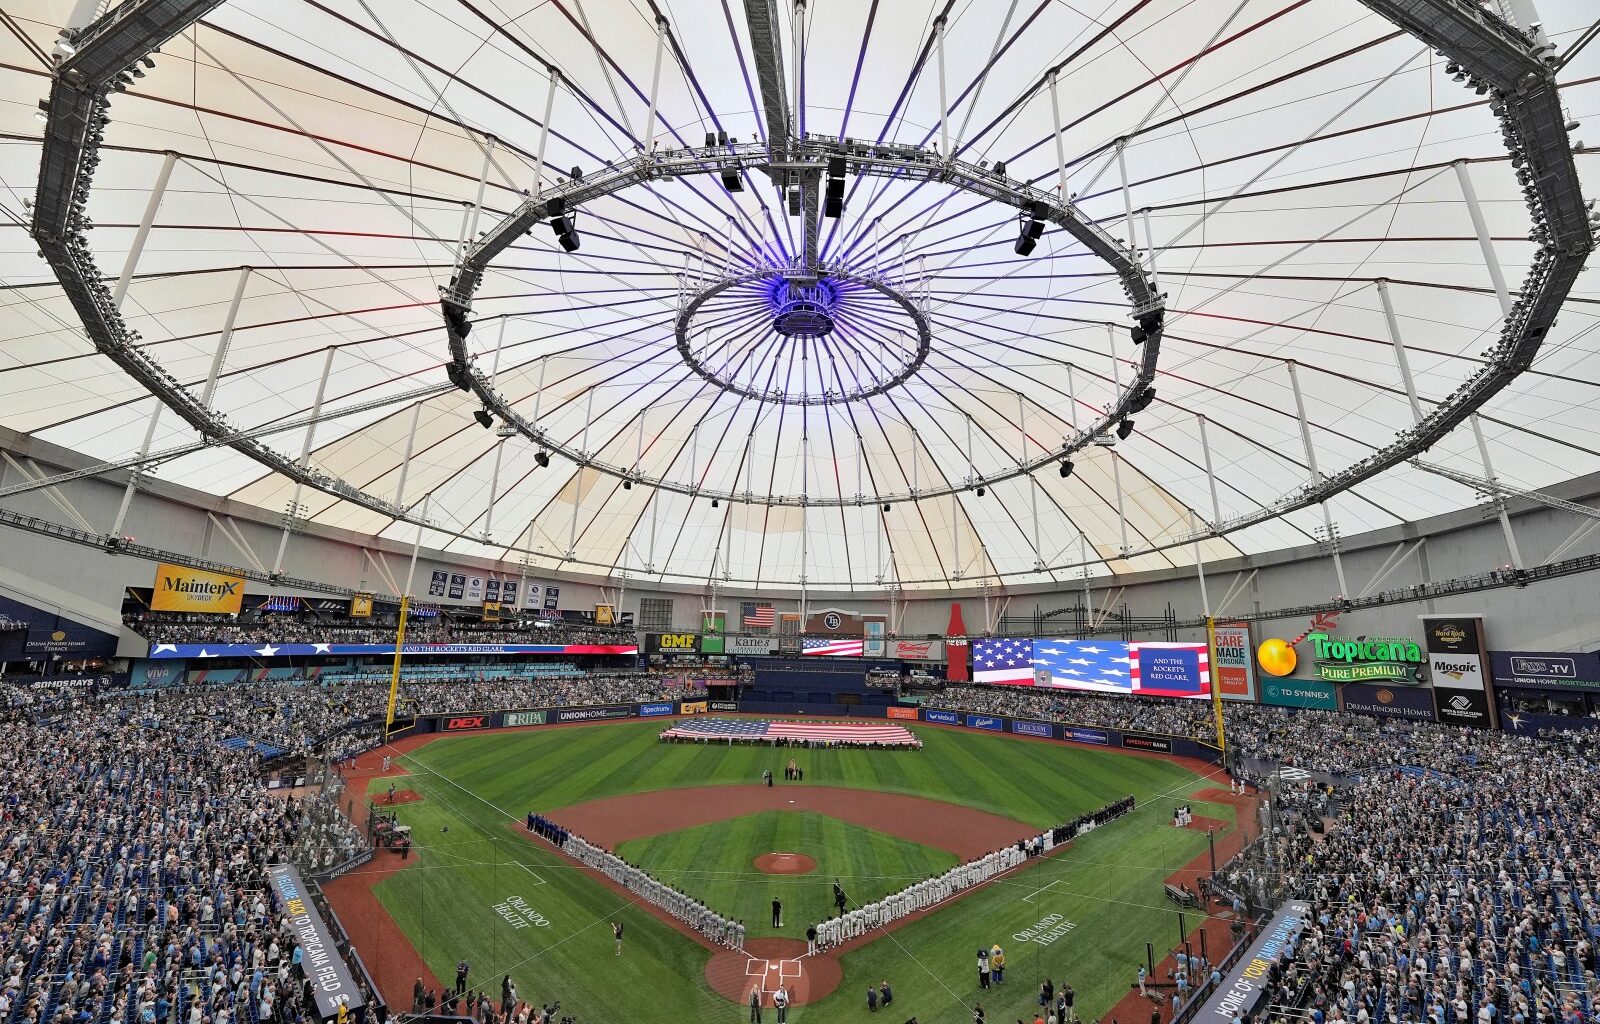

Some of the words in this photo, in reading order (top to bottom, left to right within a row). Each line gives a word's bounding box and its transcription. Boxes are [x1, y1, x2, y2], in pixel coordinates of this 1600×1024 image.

[162, 576, 240, 600] MaintenX
[187, 594, 212, 602] SKYDECK
[662, 634, 696, 648] GMF
[1215, 636, 1244, 647] CARE
[1308, 634, 1422, 662] Tropicana
[1216, 648, 1246, 658] MADE
[1322, 666, 1350, 678] PURE
[1352, 665, 1407, 678] PREMIUM
[1434, 662, 1476, 672] Mosaic
[1516, 659, 1548, 673] Rays
[146, 668, 169, 679] VIVA
[34, 680, 68, 689] SOMOS
[70, 678, 94, 687] RAYS
[1294, 690, 1330, 699] SYNNEX
[644, 706, 668, 714] Spectrum
[1346, 702, 1372, 712] DREAM
[1372, 704, 1402, 714] FINDERS
[1403, 707, 1432, 716] HOMES
[448, 716, 484, 729] DEX
[518, 712, 542, 724] RIPA
[276, 874, 300, 900] WELCOME
[286, 898, 307, 916] BACK
[506, 895, 550, 927] ORLANDO
[294, 914, 311, 925] TO
[491, 902, 530, 930] HEALTH
[1012, 913, 1063, 942] ORLANDO
[1032, 920, 1077, 946] HEALTH
[1271, 926, 1288, 944] BAY
[299, 924, 329, 968] TROPICANA
[1256, 939, 1282, 960] TAMPA
[1242, 958, 1270, 979] YOUR
[315, 965, 342, 992] FIELD
[1234, 978, 1254, 992] OF
[1214, 990, 1247, 1018] HOME
